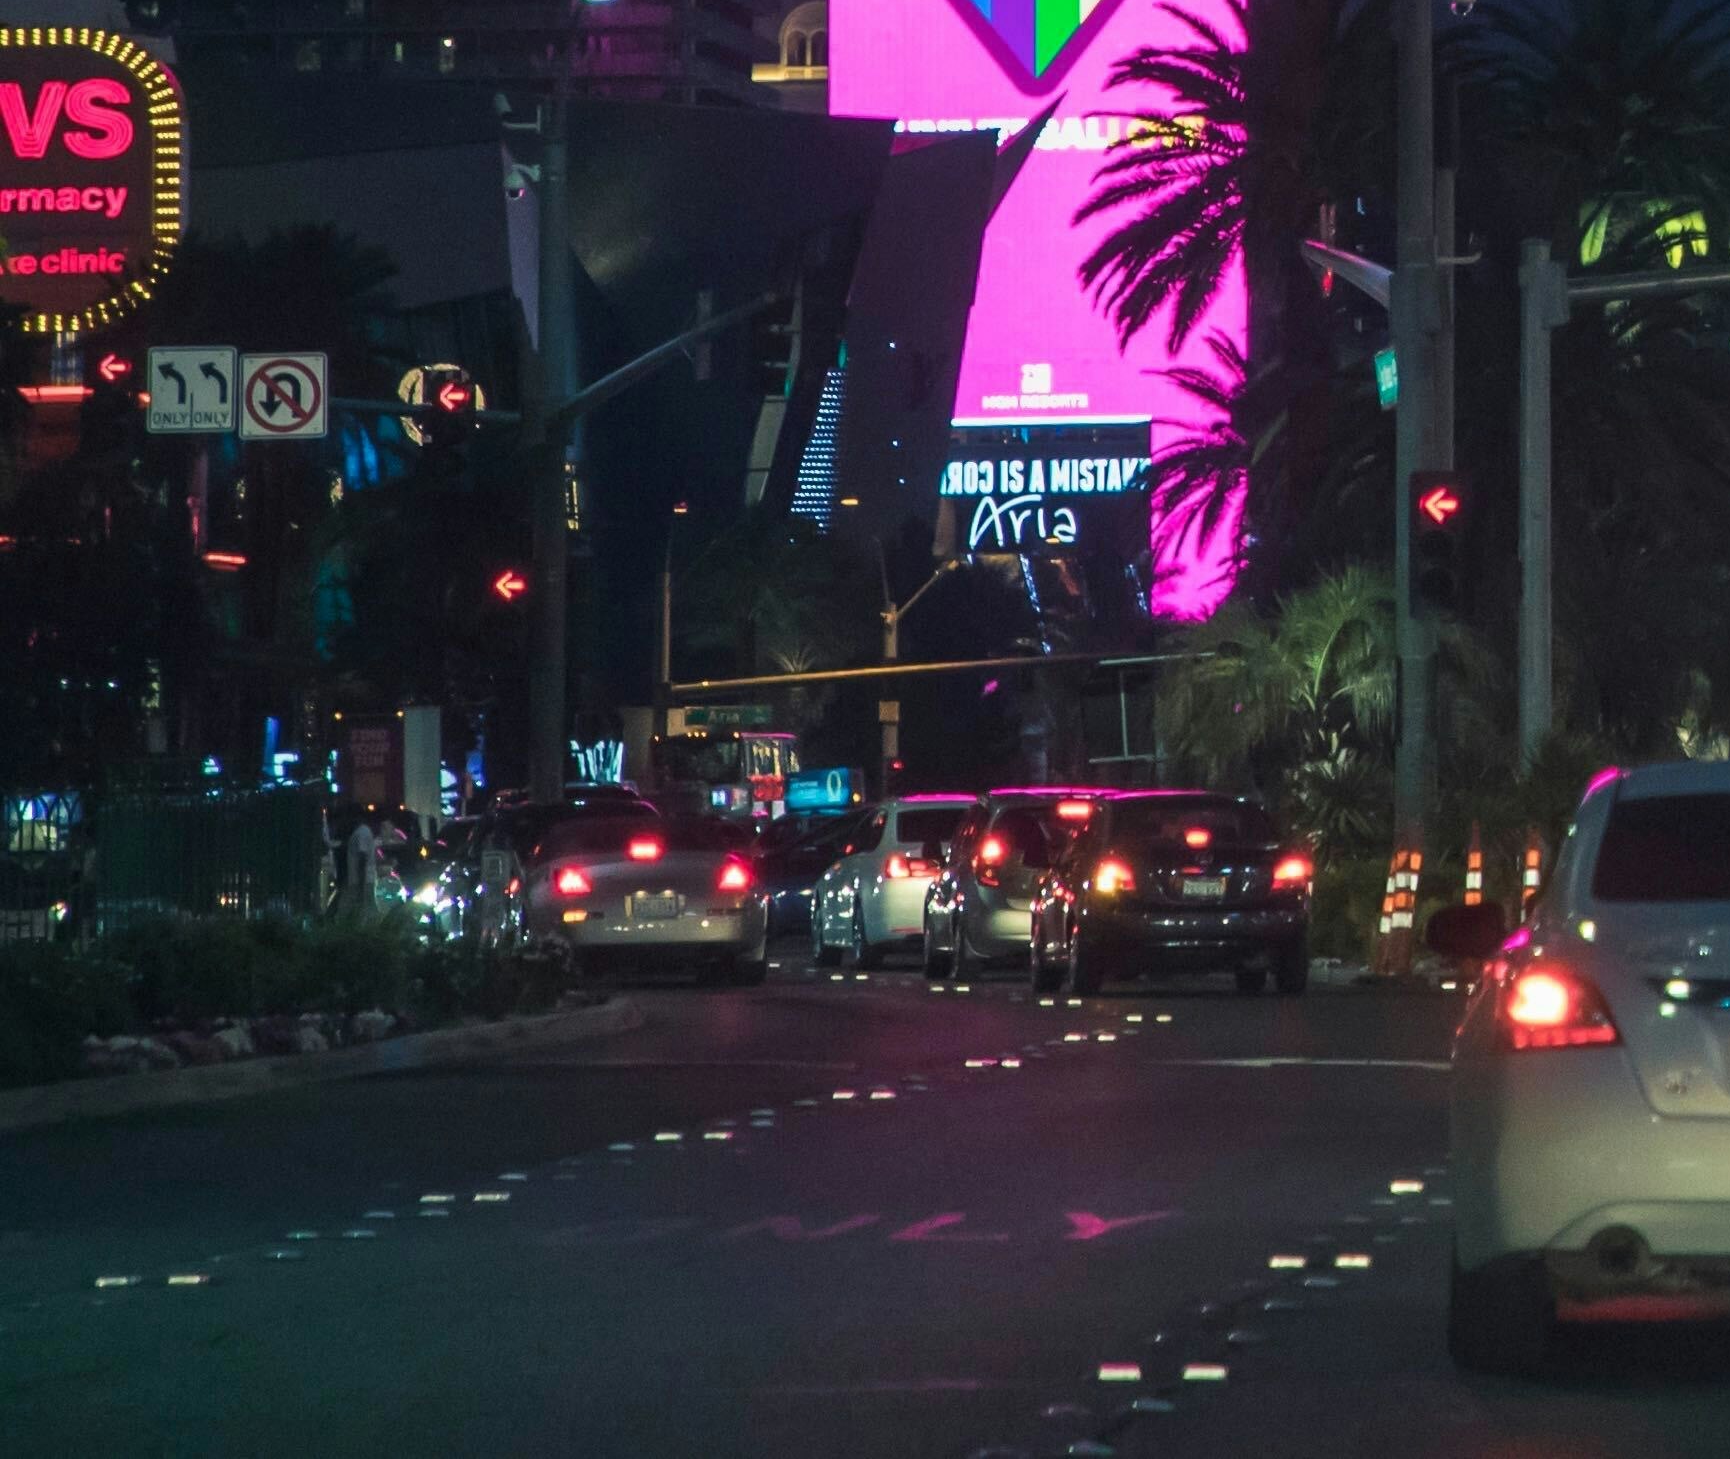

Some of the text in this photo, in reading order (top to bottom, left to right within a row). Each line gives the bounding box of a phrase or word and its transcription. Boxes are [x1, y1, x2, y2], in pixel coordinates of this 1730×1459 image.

[41, 247, 127, 275] clinic
[152, 411, 230, 426] ONLY ONLY
[1000, 457, 1153, 494] IS A MISTAK
[969, 493, 1078, 549] Aria
